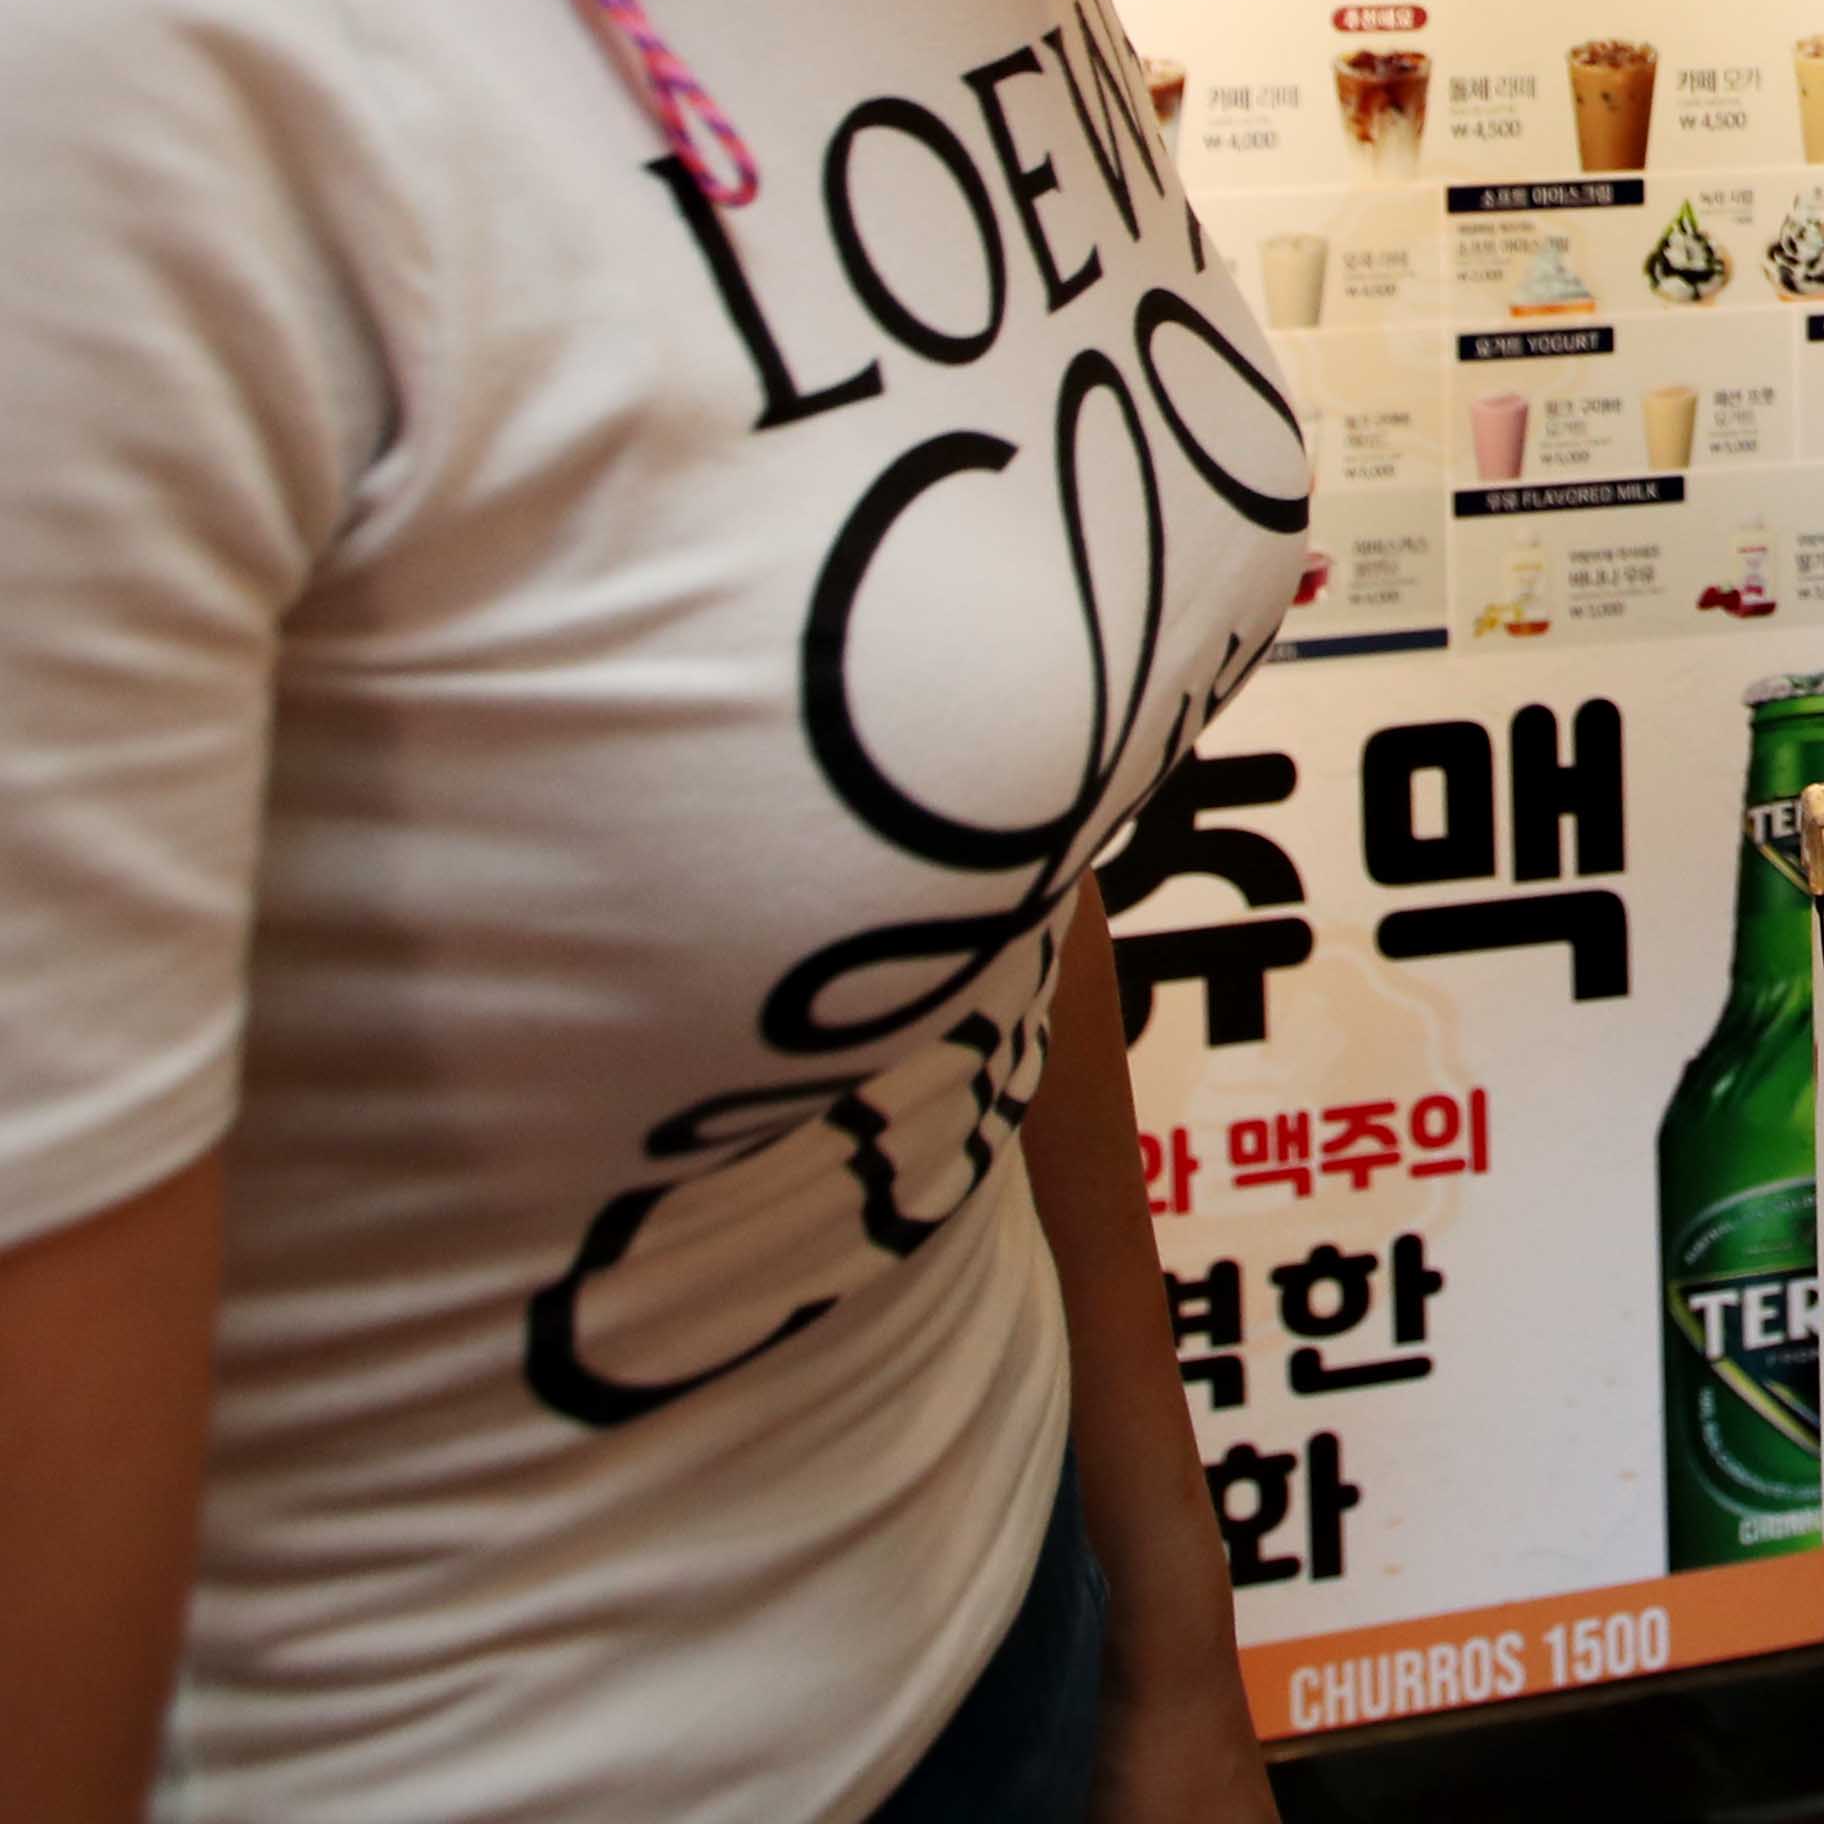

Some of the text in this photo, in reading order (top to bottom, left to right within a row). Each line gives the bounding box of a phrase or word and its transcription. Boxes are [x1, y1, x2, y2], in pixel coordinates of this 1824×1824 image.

[1528, 332, 1599, 354] YOGURT
[1522, 484, 1610, 508] FLAVORED
[1617, 480, 1658, 501] MILK
[1229, 1088, 1488, 1197] 맥주의
[1290, 1606, 1671, 1731] CHURROS 1500
